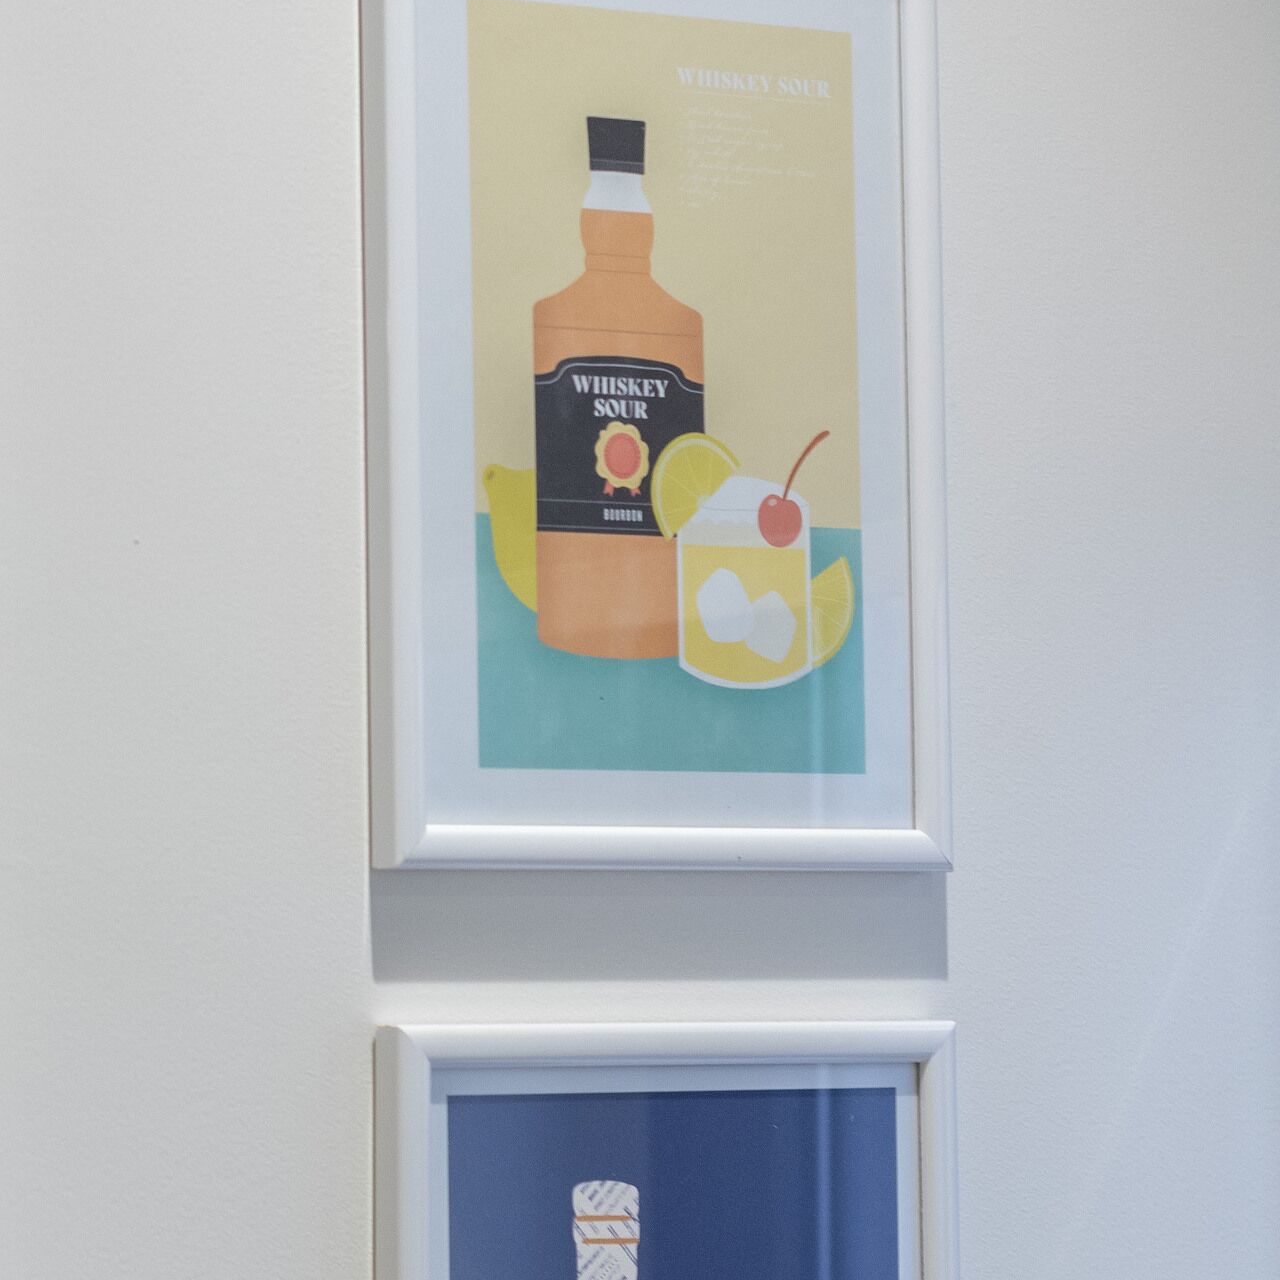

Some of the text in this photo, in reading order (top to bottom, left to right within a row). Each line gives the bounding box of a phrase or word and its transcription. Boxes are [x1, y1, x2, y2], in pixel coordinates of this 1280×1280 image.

[676, 66, 832, 98] WHISKEY SOUR
[572, 373, 669, 399] WHISKEY
[592, 397, 649, 420] SOUR
[602, 507, 644, 523] BOURBON
